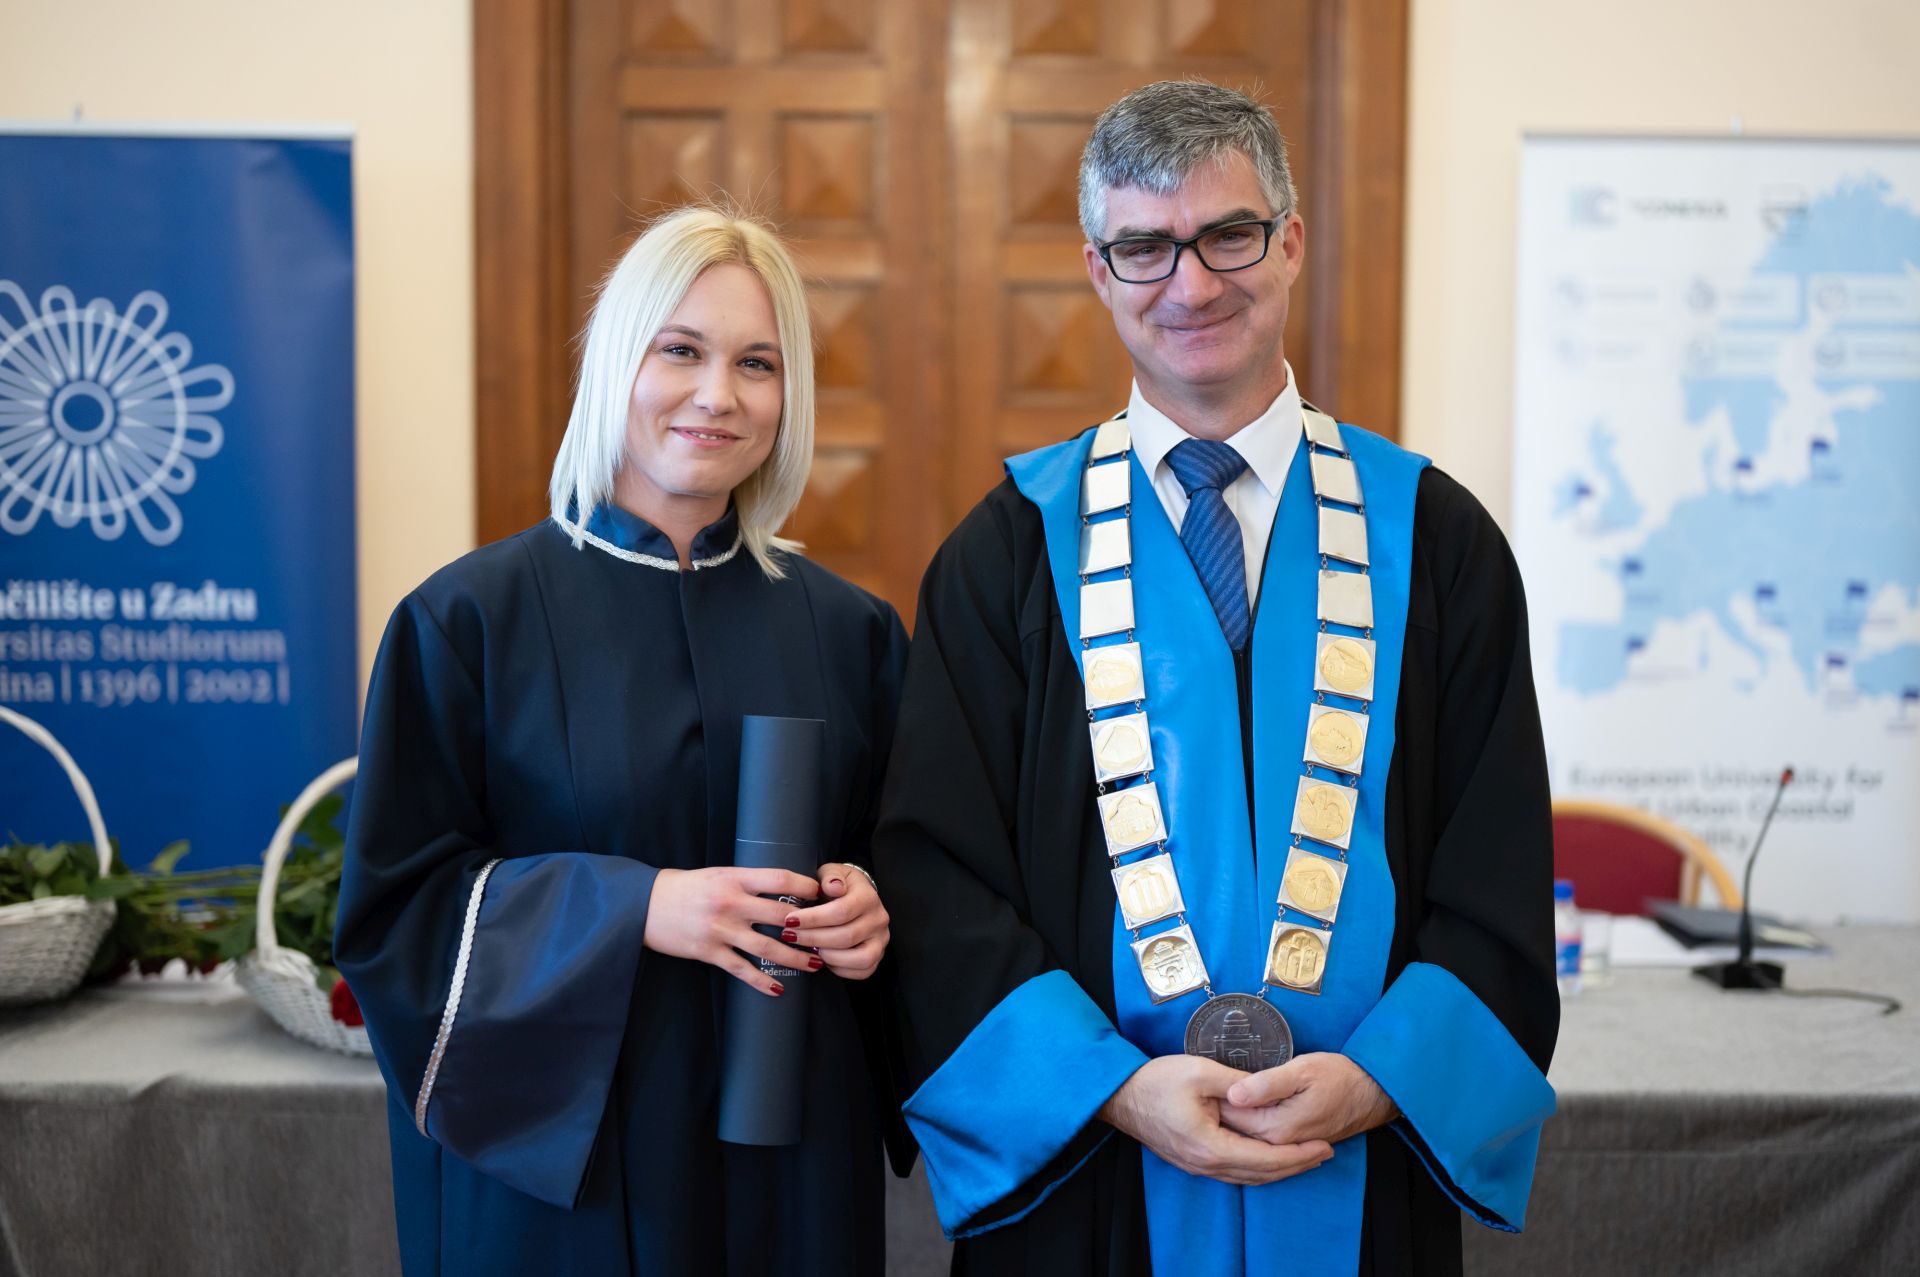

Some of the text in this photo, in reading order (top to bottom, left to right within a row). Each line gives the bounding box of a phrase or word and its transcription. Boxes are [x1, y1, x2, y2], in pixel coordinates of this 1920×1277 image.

[0, 579, 257, 621] čilište u Zadru
[101, 623, 286, 662] Studiorum
[79, 665, 161, 707] 1396
